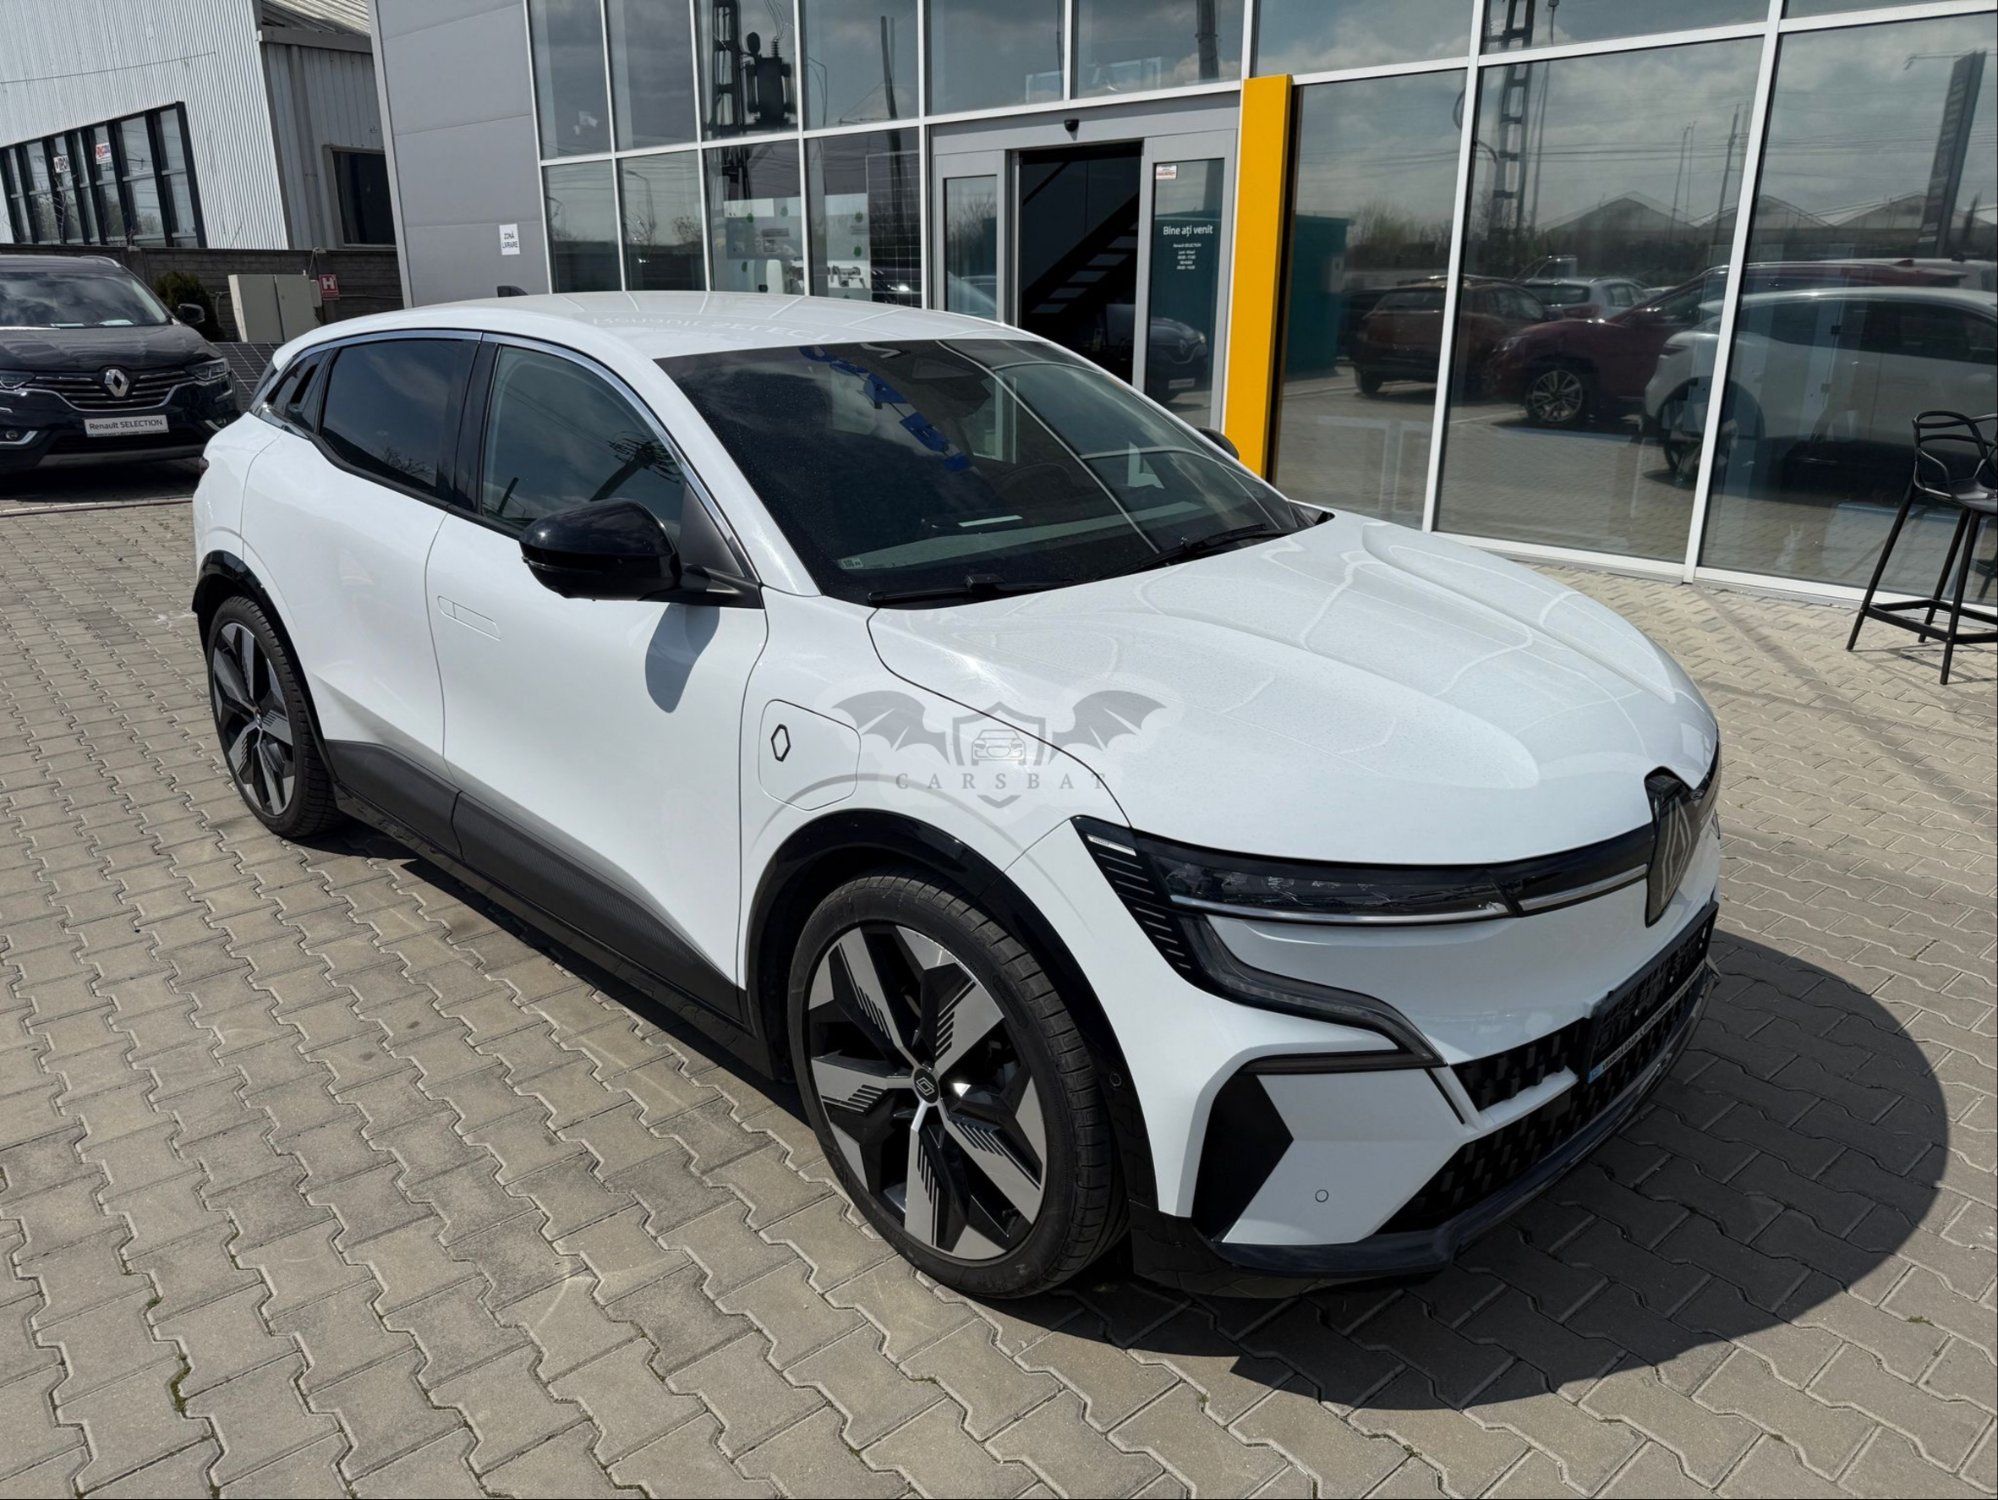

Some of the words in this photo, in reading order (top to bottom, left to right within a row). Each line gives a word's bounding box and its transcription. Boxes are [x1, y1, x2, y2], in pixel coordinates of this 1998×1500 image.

[1163, 225, 1180, 235] Bine
[1193, 225, 1213, 234] venit
[322, 278, 335, 289] H
[89, 421, 119, 430] Renault
[120, 420, 163, 428] SELECTION
